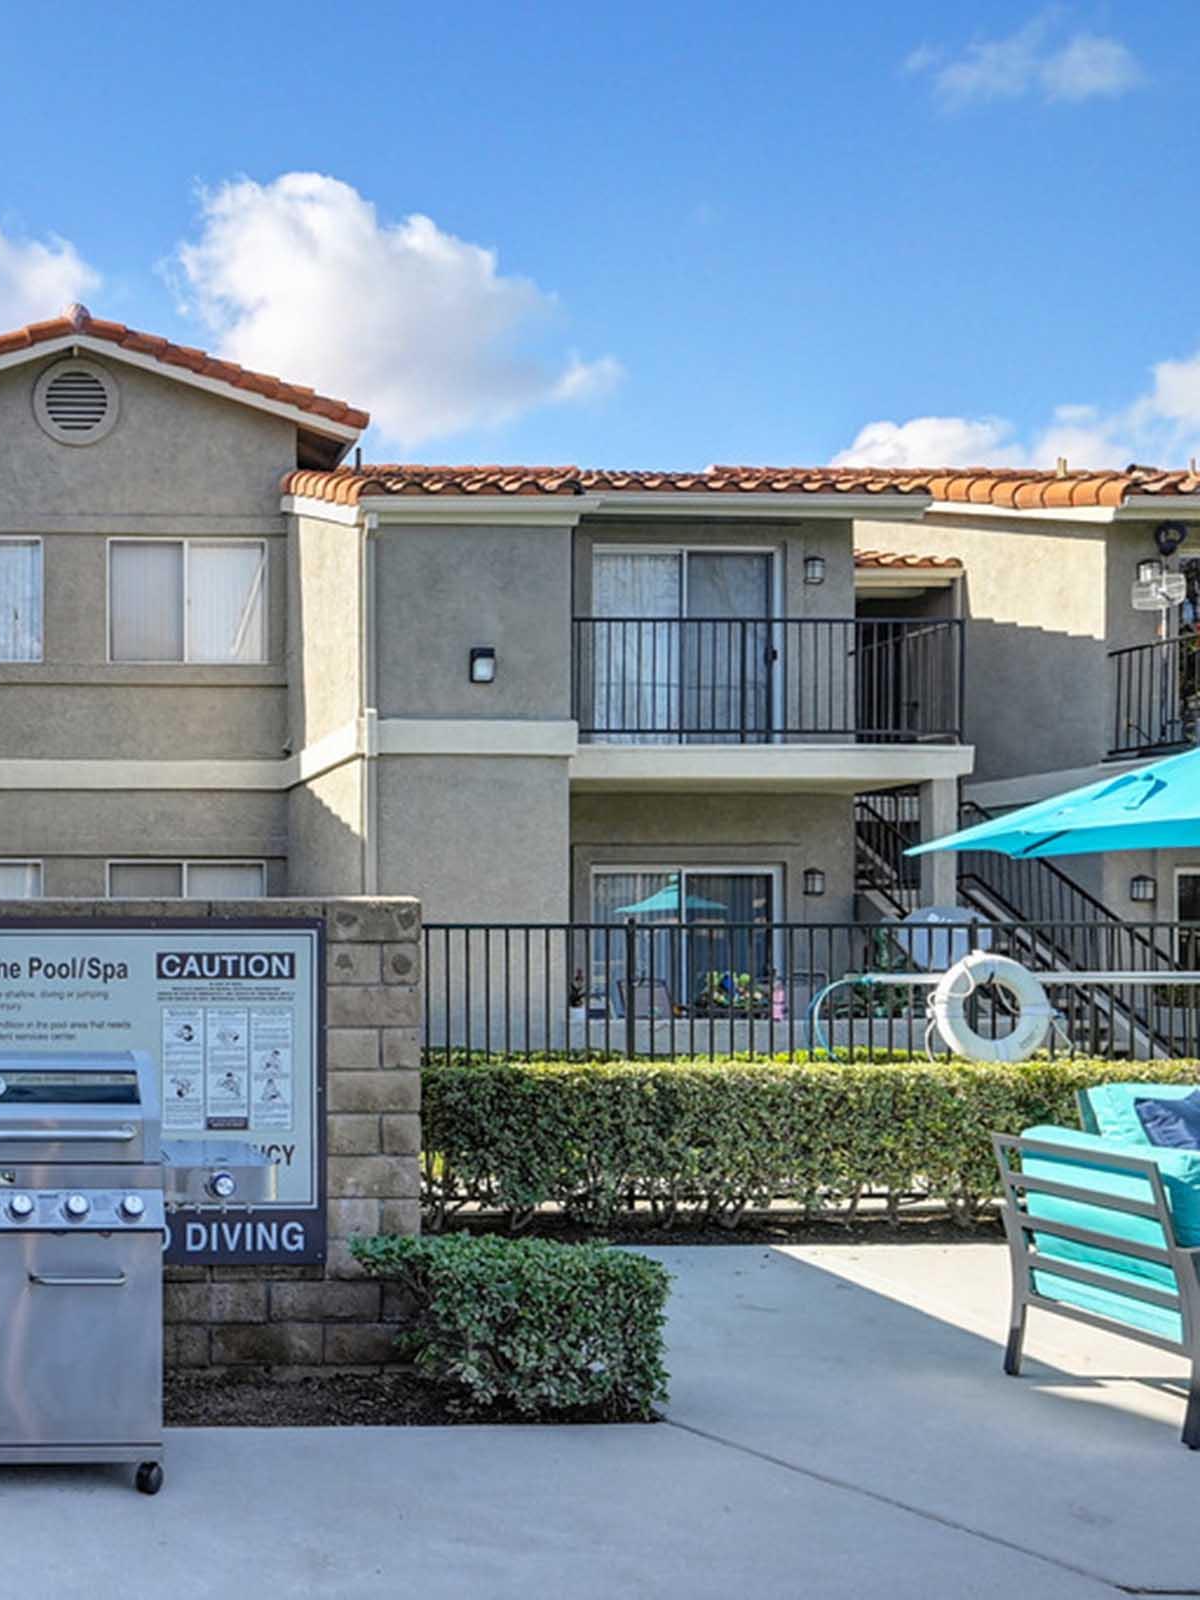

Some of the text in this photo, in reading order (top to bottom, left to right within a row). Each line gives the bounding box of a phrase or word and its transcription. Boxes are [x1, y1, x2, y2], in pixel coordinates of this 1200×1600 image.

[28, 956, 129, 984] Pool/Spa
[161, 954, 290, 977] CAUTION
[185, 1222, 305, 1251] DIVING
